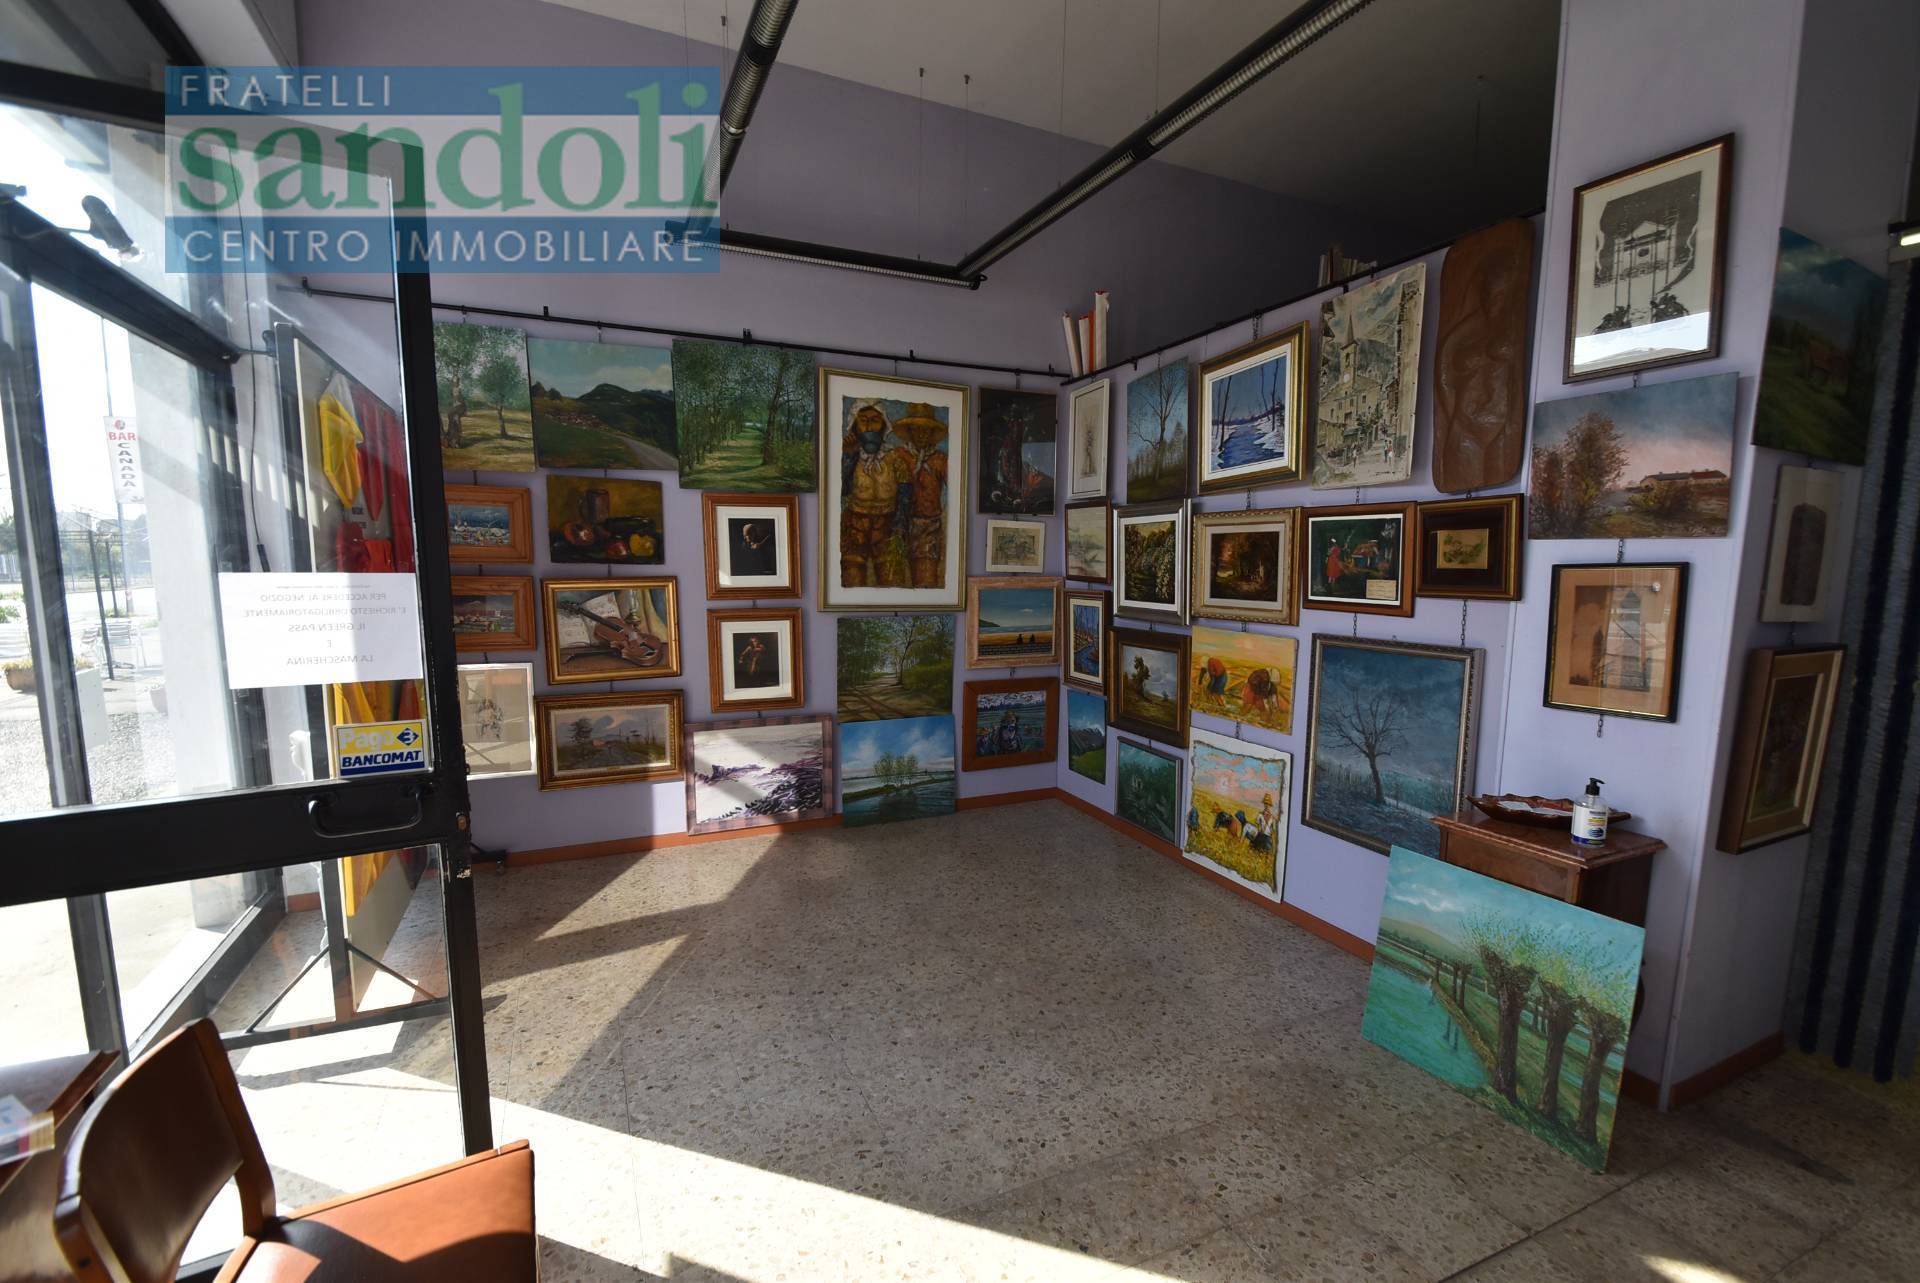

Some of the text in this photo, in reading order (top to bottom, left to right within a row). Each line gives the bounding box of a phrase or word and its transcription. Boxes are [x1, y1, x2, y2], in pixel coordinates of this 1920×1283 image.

[108, 432, 137, 441] BAR
[118, 442, 136, 487] CANADA
[338, 728, 394, 753] Pago
[342, 750, 422, 768] BANCOMAT
